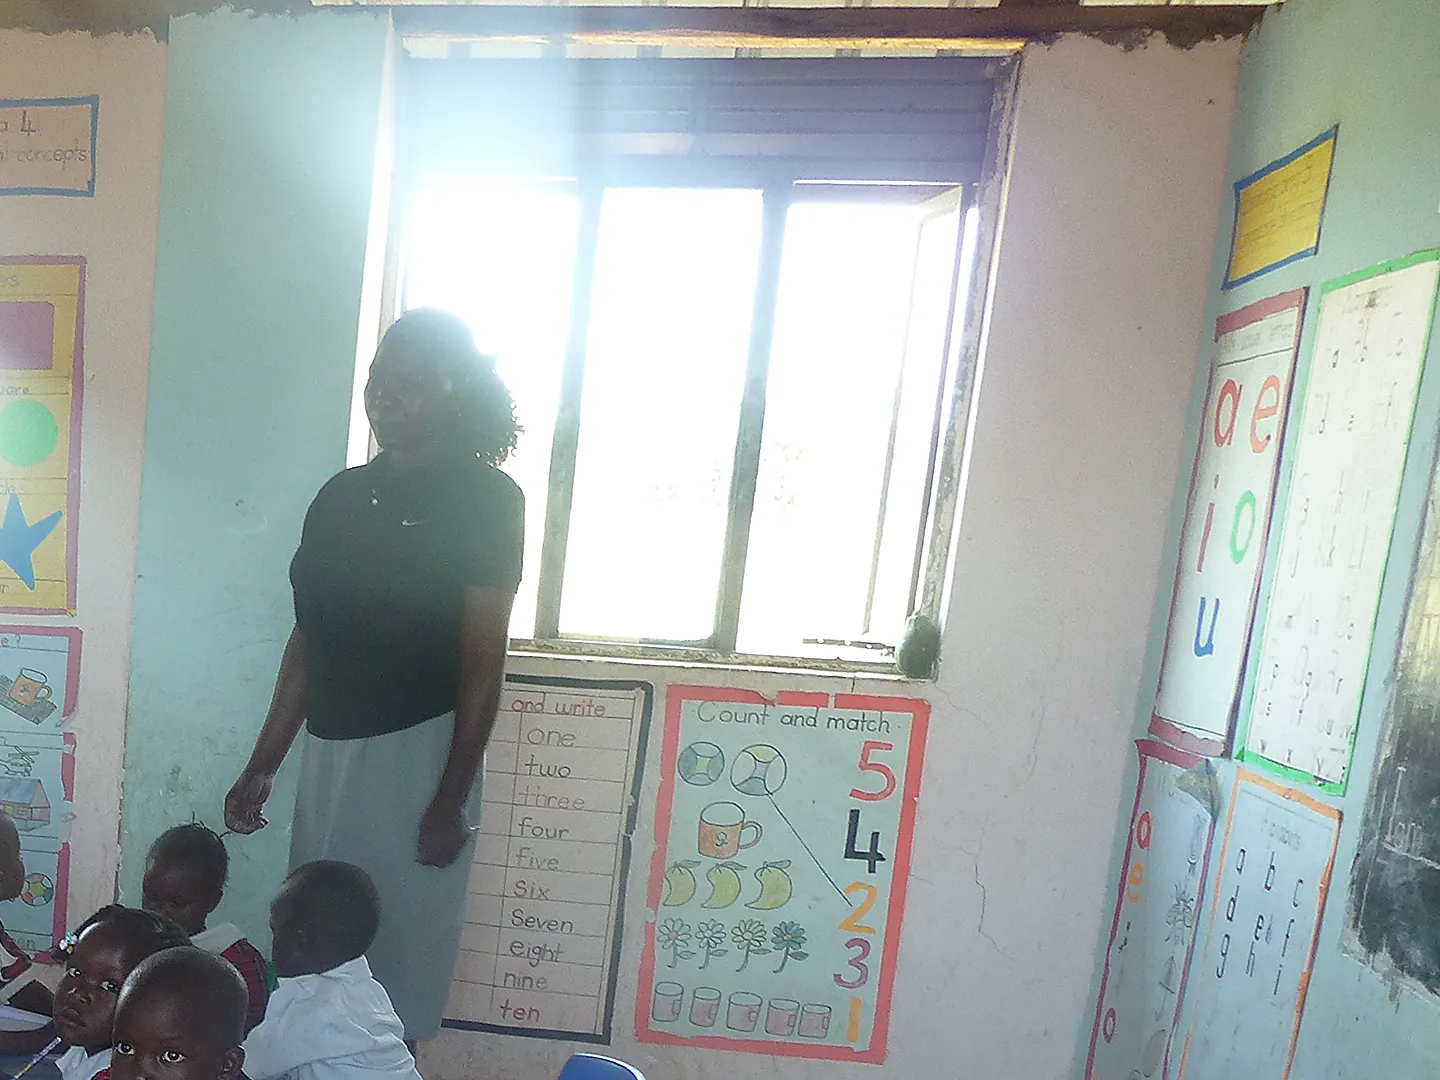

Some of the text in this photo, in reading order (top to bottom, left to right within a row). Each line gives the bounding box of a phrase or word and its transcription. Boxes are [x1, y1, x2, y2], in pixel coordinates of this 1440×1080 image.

[19, 110, 37, 137] 4
[1214, 375, 1280, 454] a e
[1229, 490, 1257, 565] o
[1194, 596, 1220, 657] u
[555, 699, 606, 717] write
[698, 701, 891, 734] Count and match
[527, 727, 577, 747] one
[524, 754, 572, 778] two
[849, 740, 897, 801] 5
[518, 785, 585, 810] three
[518, 816, 570, 840] four
[843, 808, 887, 874] 4
[1264, 851, 1276, 891] b
[513, 879, 551, 901] Six
[1226, 884, 1241, 922] d
[511, 908, 574, 935] Seven
[838, 881, 877, 936] 2
[833, 937, 871, 989] 3
[1216, 933, 1230, 979] g
[503, 971, 549, 990] nine
[500, 999, 541, 1022] ten
[846, 996, 862, 1042] 1
